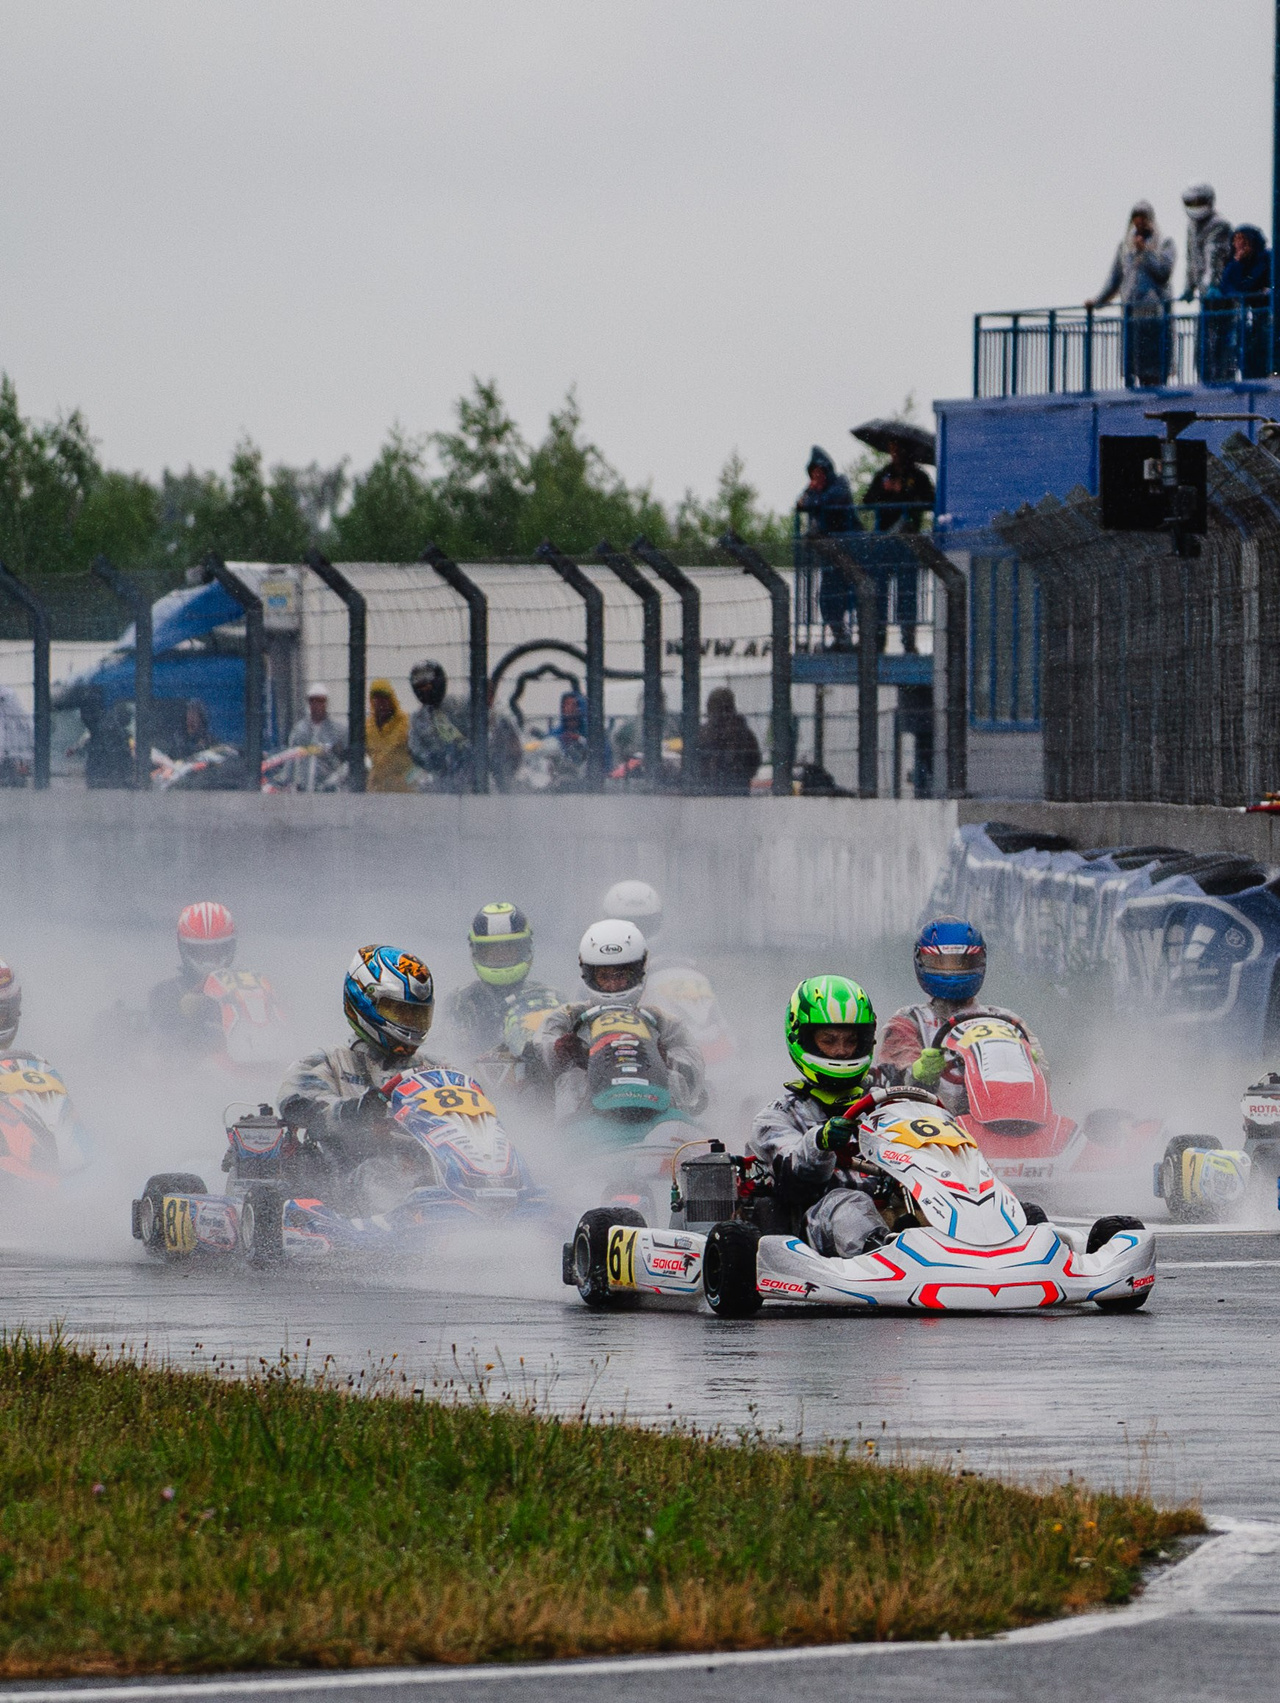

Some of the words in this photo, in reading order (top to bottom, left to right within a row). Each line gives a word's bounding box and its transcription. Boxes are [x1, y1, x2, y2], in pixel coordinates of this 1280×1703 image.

[434, 1088, 480, 1108] 87
[910, 1119, 967, 1138] 61
[882, 1150, 913, 1164] SOKOL
[166, 1199, 188, 1247] 87
[609, 1229, 638, 1282] 61
[652, 1257, 686, 1272] SOKOL
[760, 1279, 808, 1293] SOKOL
